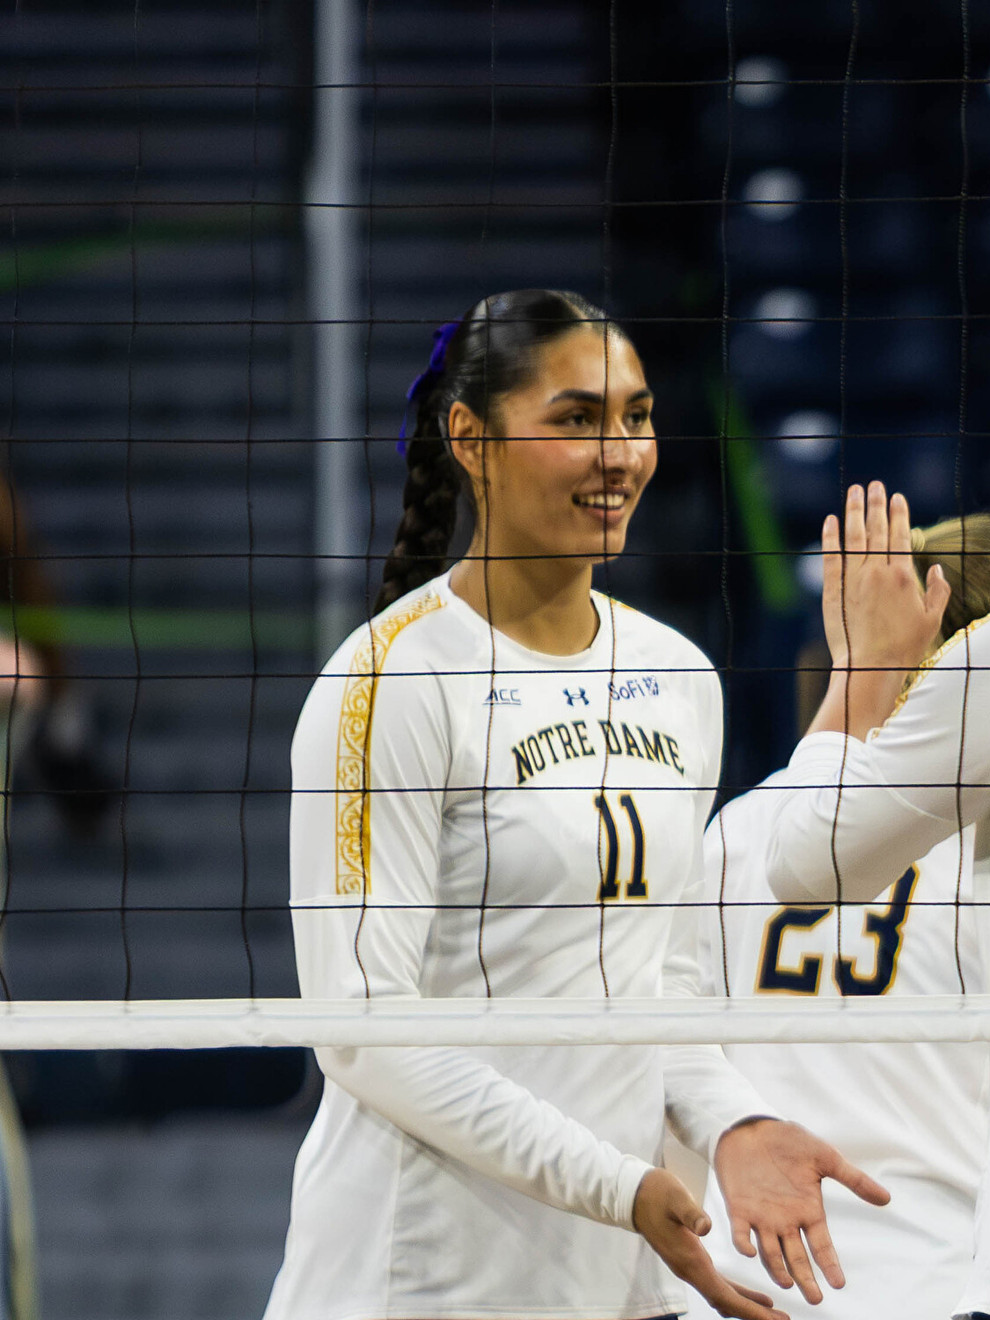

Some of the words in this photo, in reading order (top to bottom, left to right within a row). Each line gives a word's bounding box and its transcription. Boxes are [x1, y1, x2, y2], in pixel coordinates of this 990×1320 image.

[483, 689, 521, 705] ACC
[608, 679, 645, 701] SoFi
[510, 720, 596, 785] NOTRE
[598, 720, 685, 776] DAME
[592, 791, 649, 901] 11
